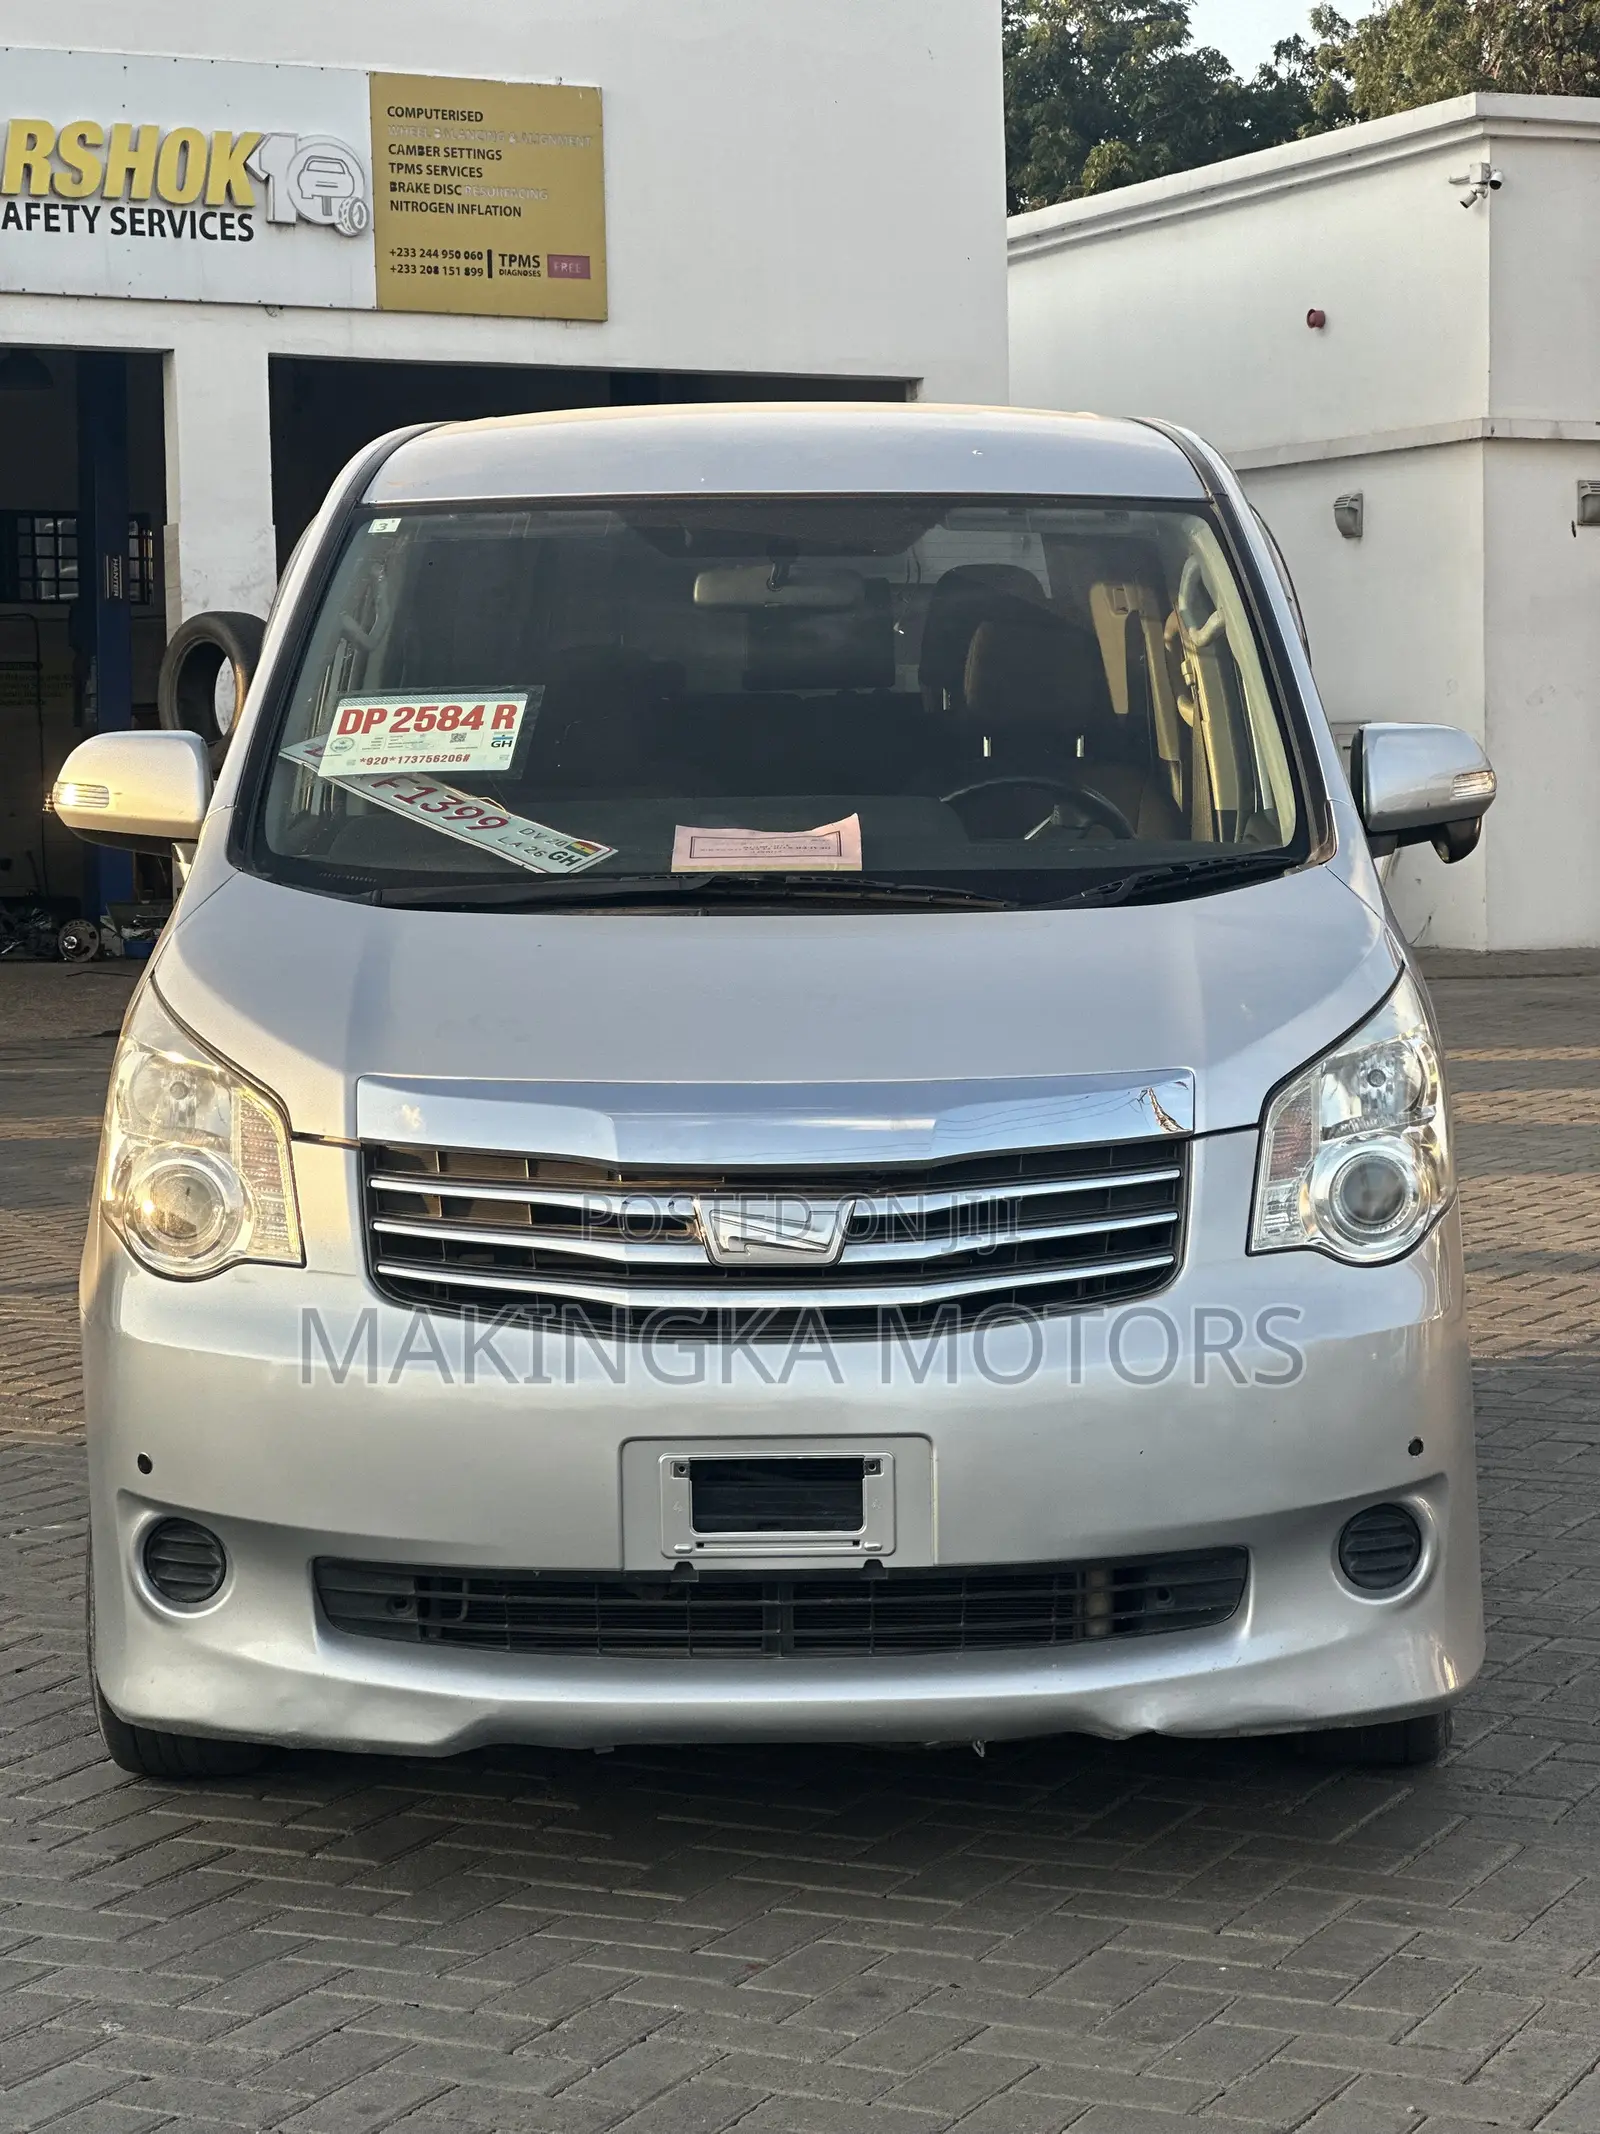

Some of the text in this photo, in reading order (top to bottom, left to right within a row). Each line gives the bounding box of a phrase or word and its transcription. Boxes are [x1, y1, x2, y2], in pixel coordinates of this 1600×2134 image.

[387, 106, 484, 122] COMPUTERISED
[388, 125, 592, 147] WHEEL BALANCING & ALIGNMENT
[388, 144, 502, 160] CAMBER SETTINGS
[389, 162, 483, 178] TPMS SERVICES
[389, 181, 431, 194] BRAKE
[434, 183, 462, 196] DISC
[390, 200, 522, 217] NITROGEN INFLATION
[1, 201, 254, 242] AFETY SERVICES
[389, 247, 483, 261] +233 244 950 060
[498, 253, 541, 269] TPMS
[389, 264, 484, 277] +233 208 151 899
[499, 268, 541, 278] DIAGNOSES
[337, 704, 518, 735] DP 2584 R
[491, 739, 513, 749] GH
[548, 851, 583, 867] GH
